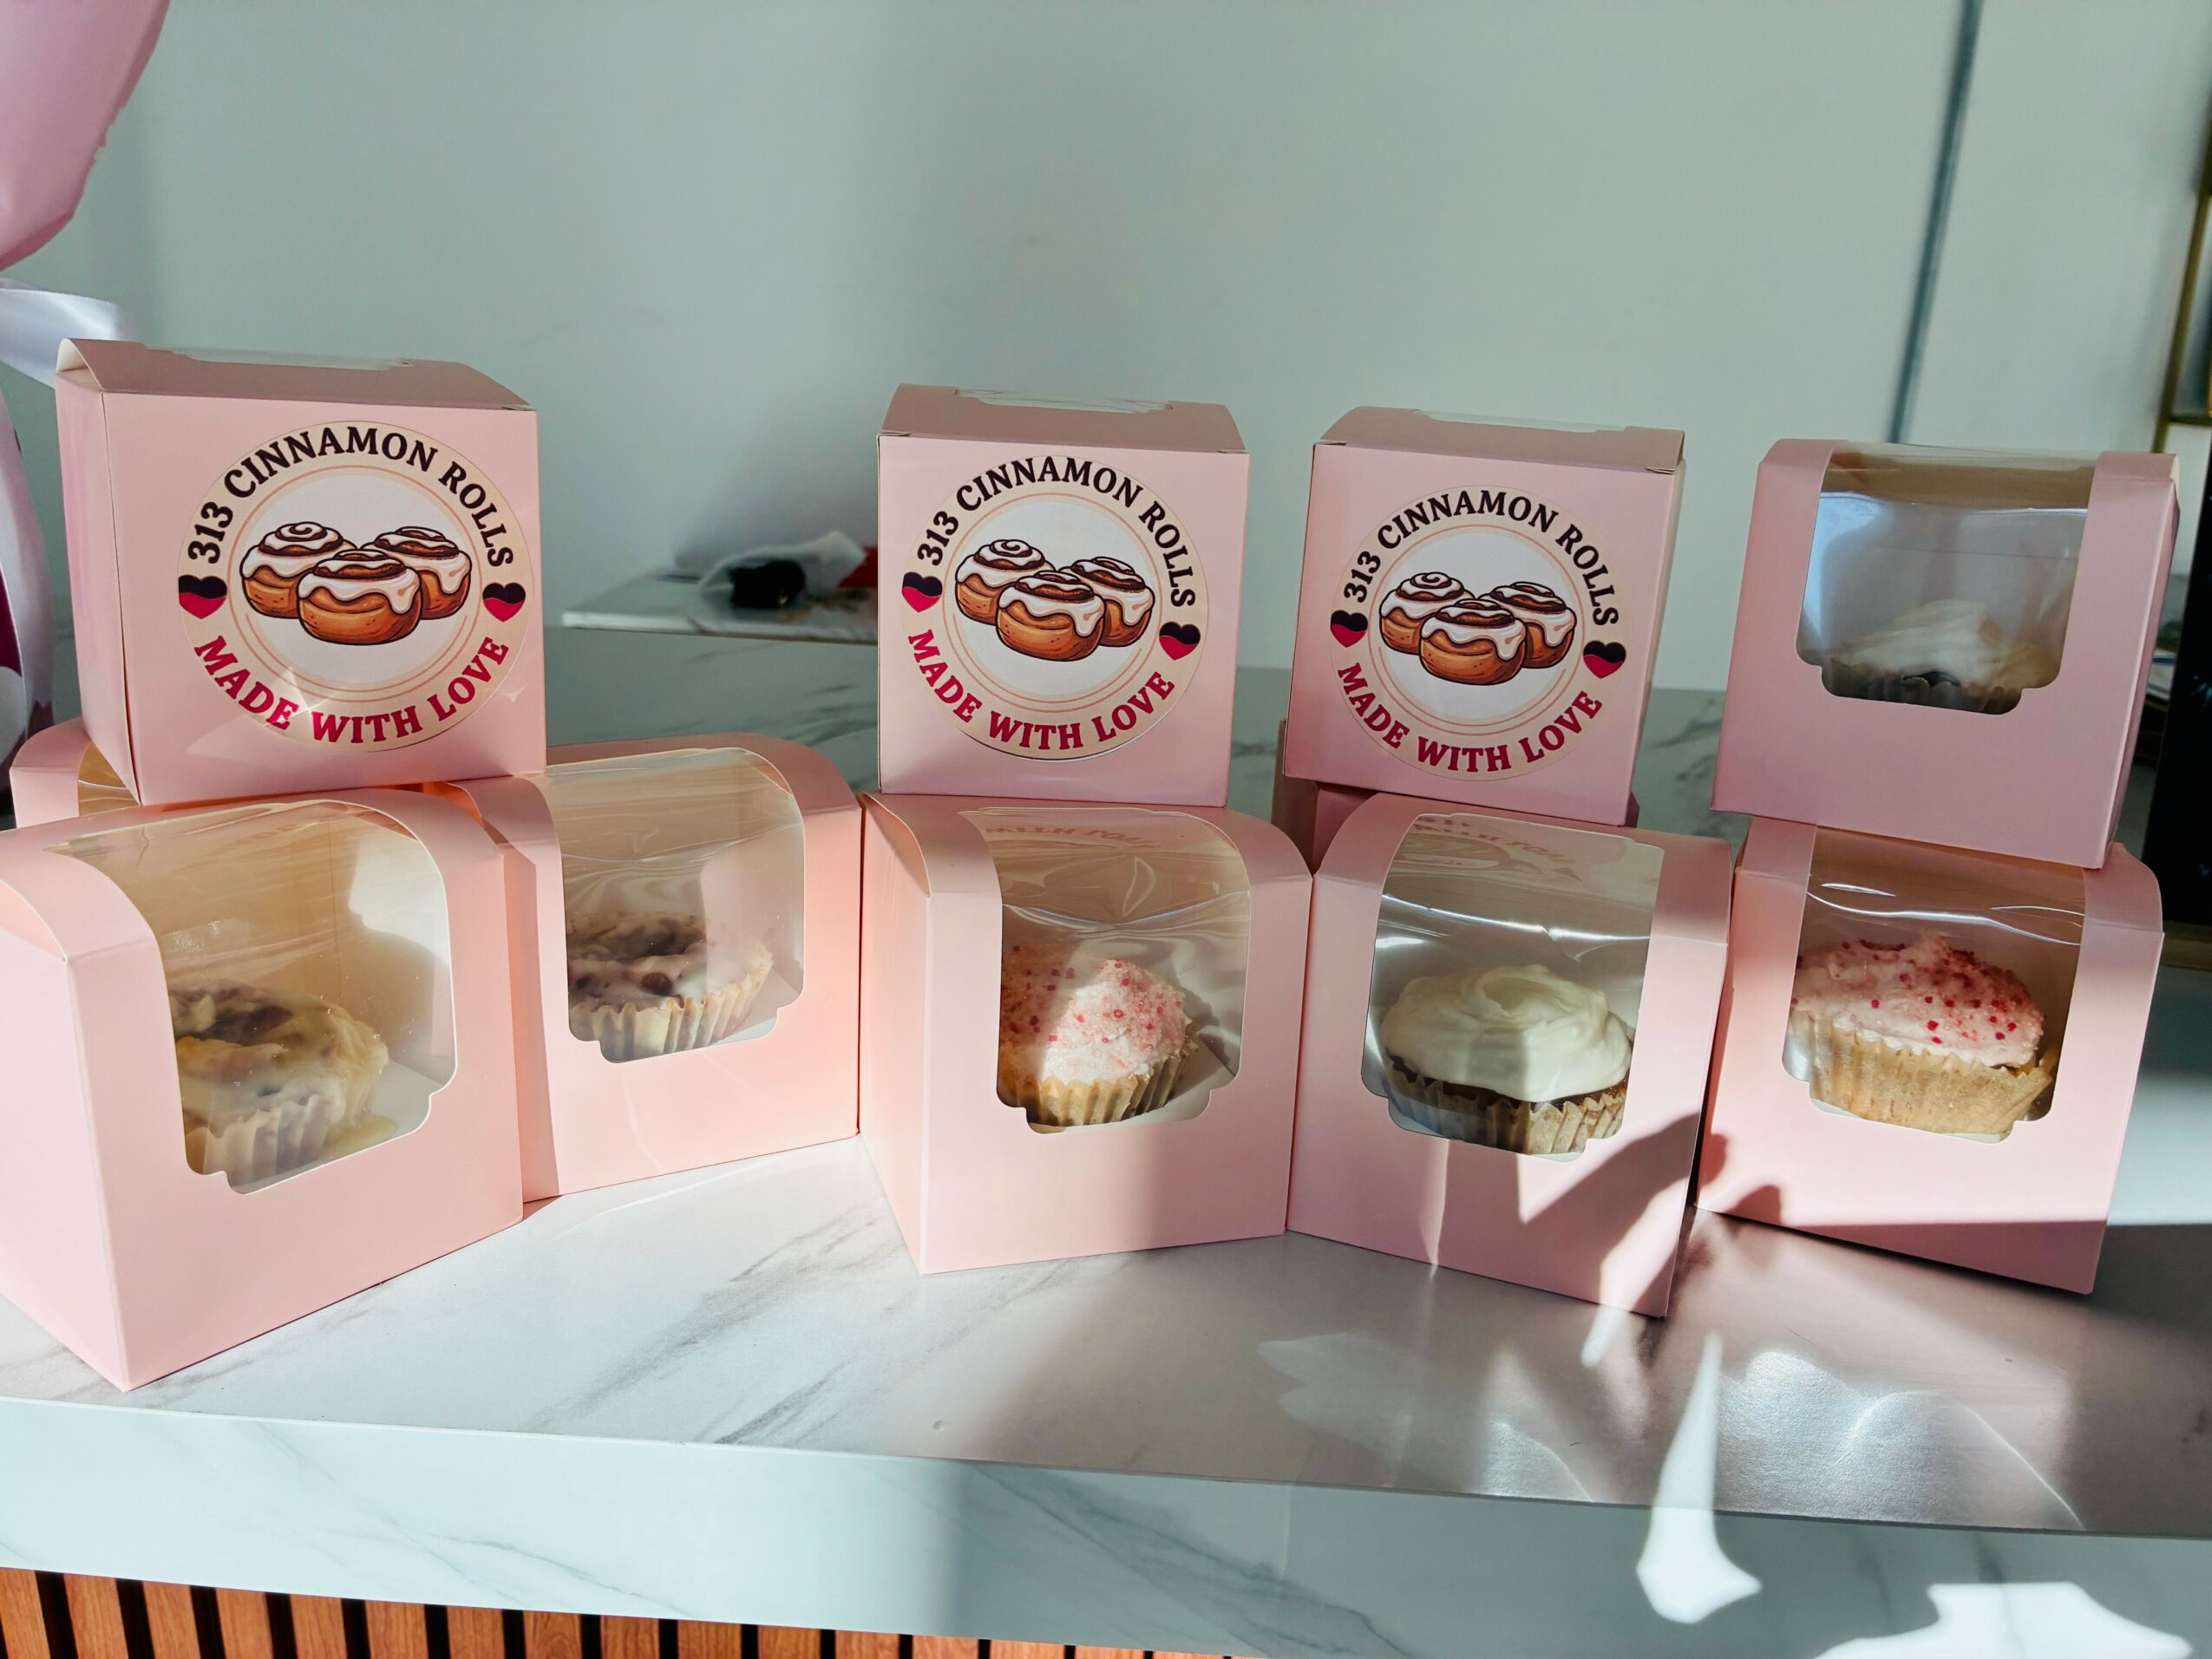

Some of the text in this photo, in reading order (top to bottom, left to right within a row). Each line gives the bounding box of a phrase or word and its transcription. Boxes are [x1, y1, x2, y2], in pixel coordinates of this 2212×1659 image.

[187, 426, 514, 567] 313 CINNAMON ROLLS
[917, 455, 1195, 608] 313 CINNAMON ROLLS
[1344, 489, 1619, 626] 313 CINNAMON ROLLS
[193, 635, 509, 744] MADE WITH LOVE
[907, 629, 1175, 750] MADE WITH LOVE
[1338, 662, 1603, 773] MADE WITH LOVE
